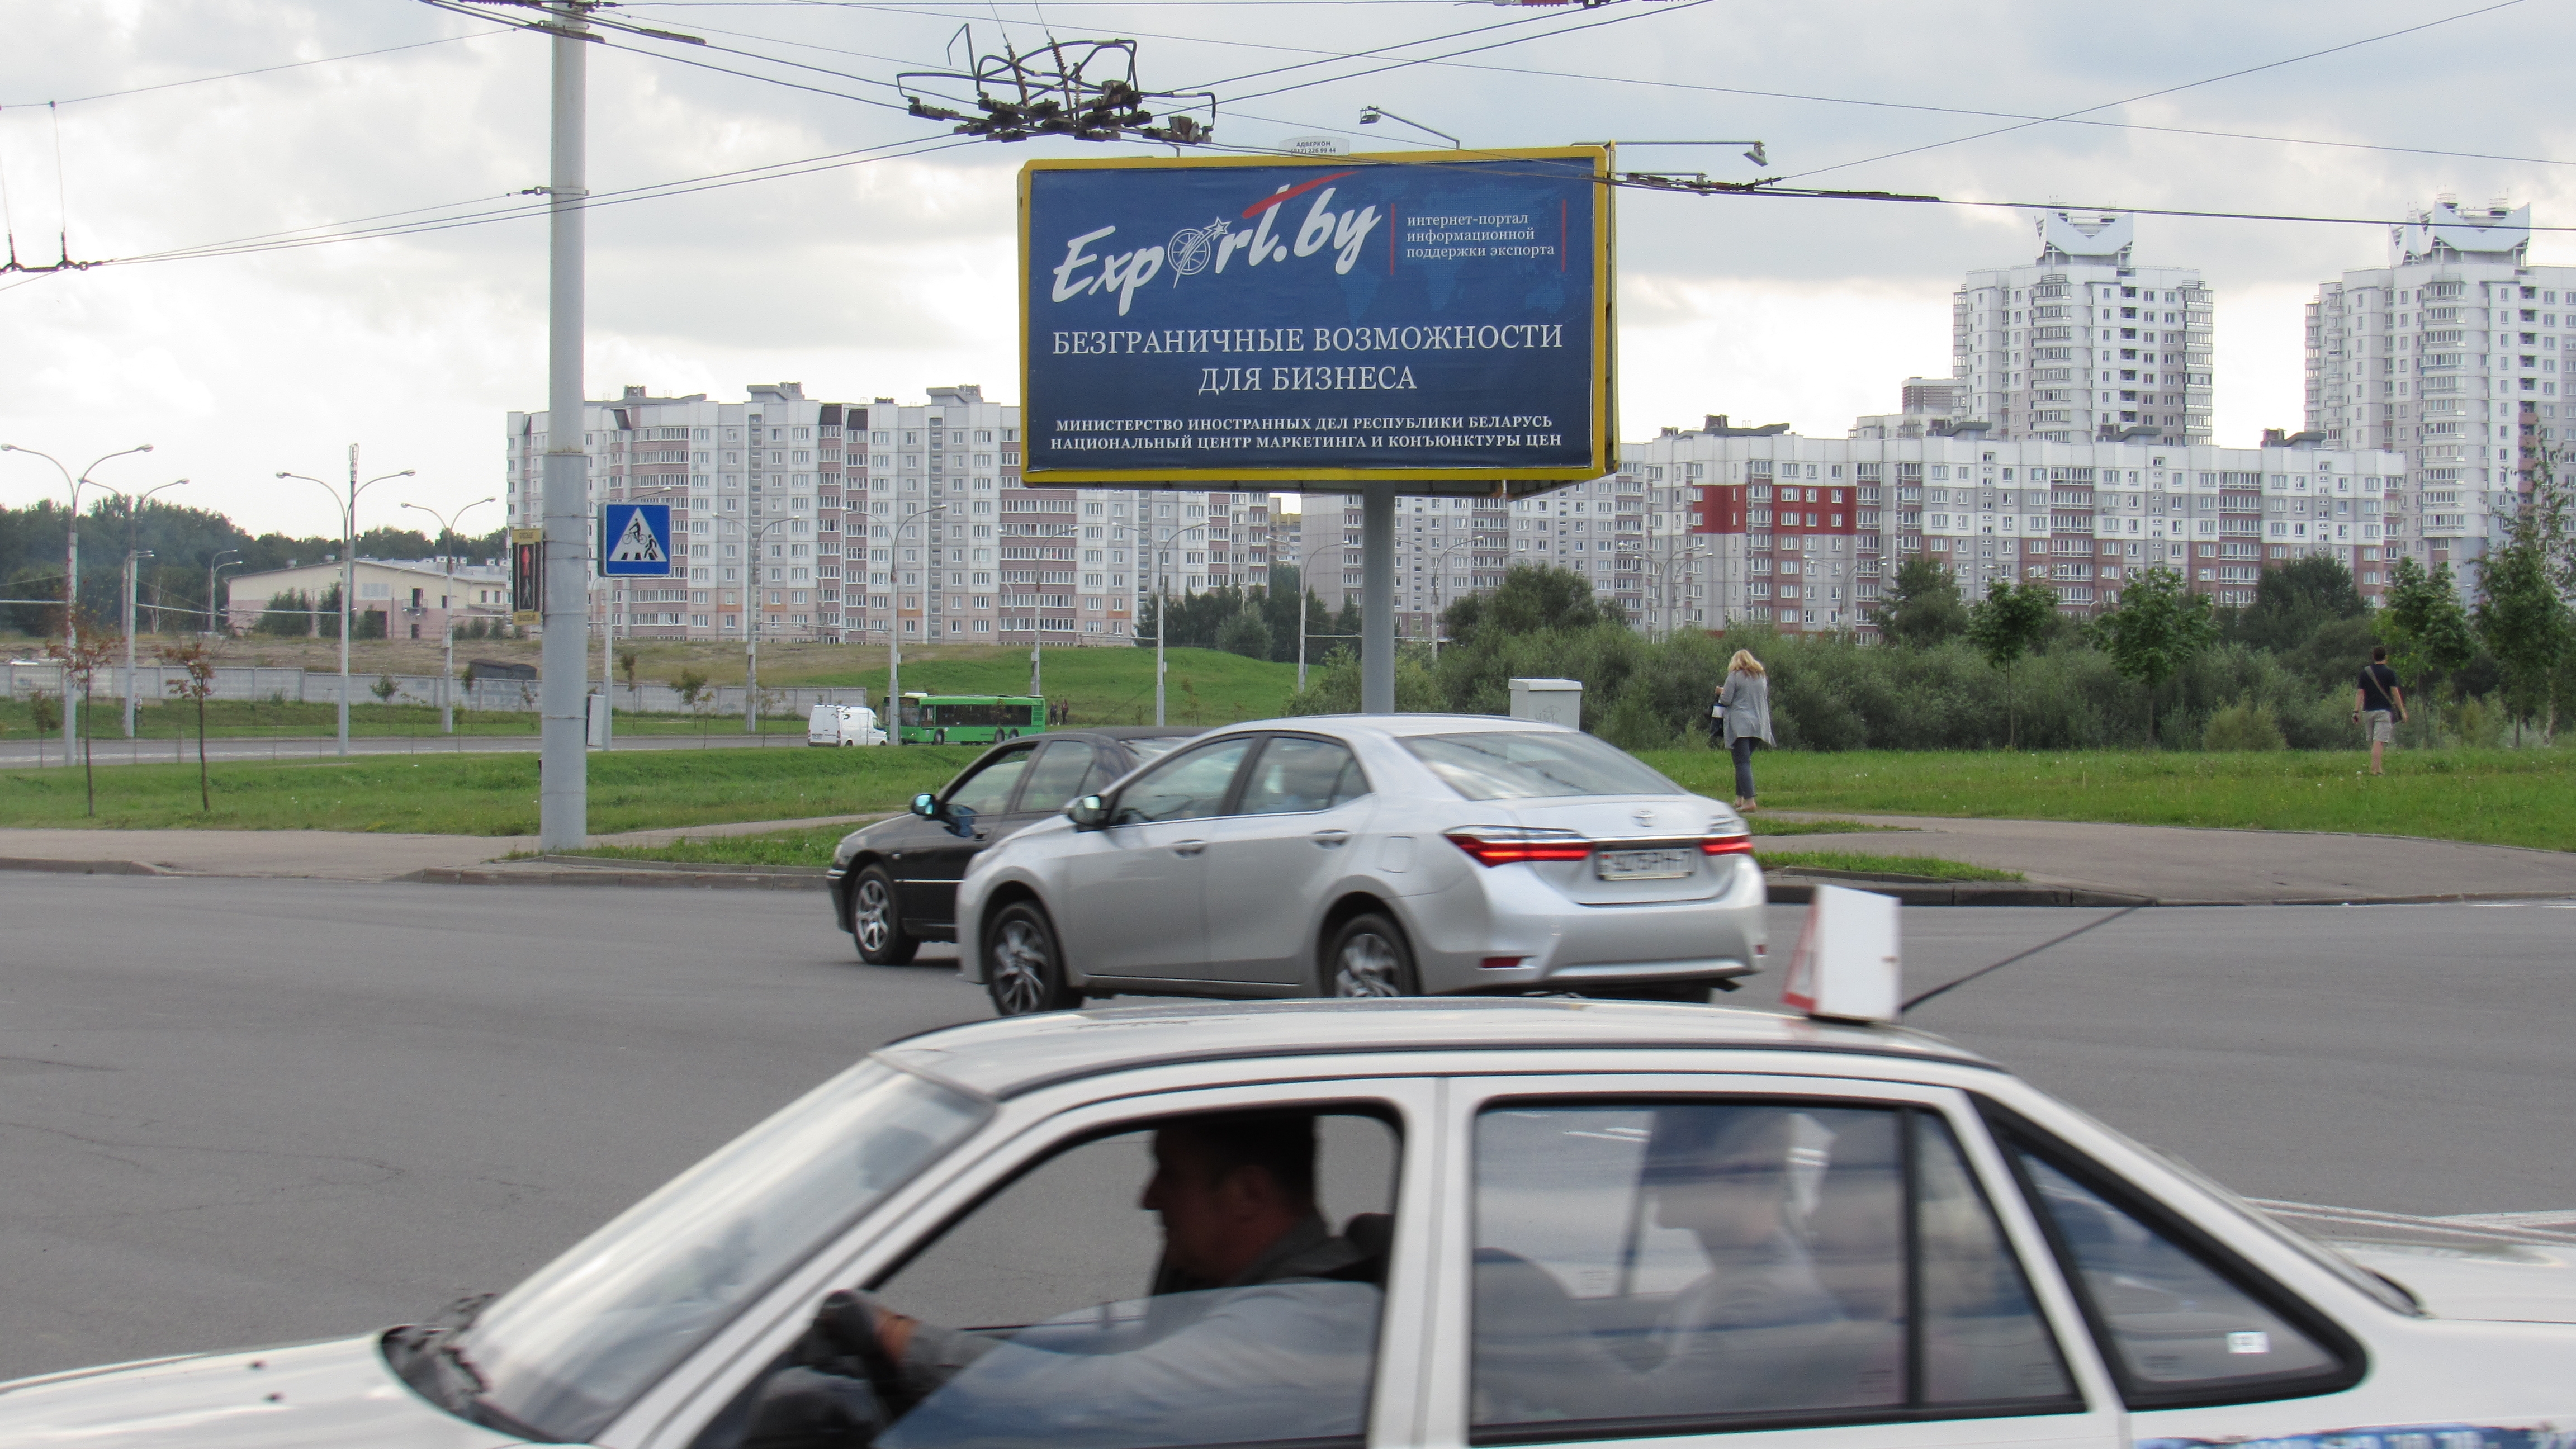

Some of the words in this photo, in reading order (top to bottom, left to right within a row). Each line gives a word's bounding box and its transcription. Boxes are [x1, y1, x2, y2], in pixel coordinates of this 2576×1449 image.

[1407, 214, 1528, 228] интернет-портал
[1407, 227, 1535, 244] информационной
[1407, 247, 1486, 261] поддержки
[1490, 245, 1555, 259] экспорта
[1052, 328, 1304, 354] БЕЗГРАНИЧНЫЕ
[1313, 324, 1563, 351] ВОЗМОЖНОСТИ
[1198, 367, 1262, 396] ДЛЯ
[1272, 366, 1418, 390] БИЗНЕСА
[1055, 419, 1183, 432] МИНИСТЕРСТВО
[1187, 418, 1312, 431] ИНОСТРАННЫХ
[1315, 418, 1348, 430] ДЕЛ
[1353, 416, 1464, 429] РЕСПУБЛИКИ
[1468, 415, 1553, 428] БЕЛАРУСЬ
[1050, 434, 1192, 451] НАЦИОНАЛЬНЫЙ
[1197, 437, 1252, 451] ЦЕНТР
[1256, 436, 1367, 448] МАРКЕТИНГА
[1371, 435, 1383, 447] И
[1388, 434, 1521, 448] КОНЪЮНКТУРЫ
[1526, 434, 1562, 448] ЦЕН
